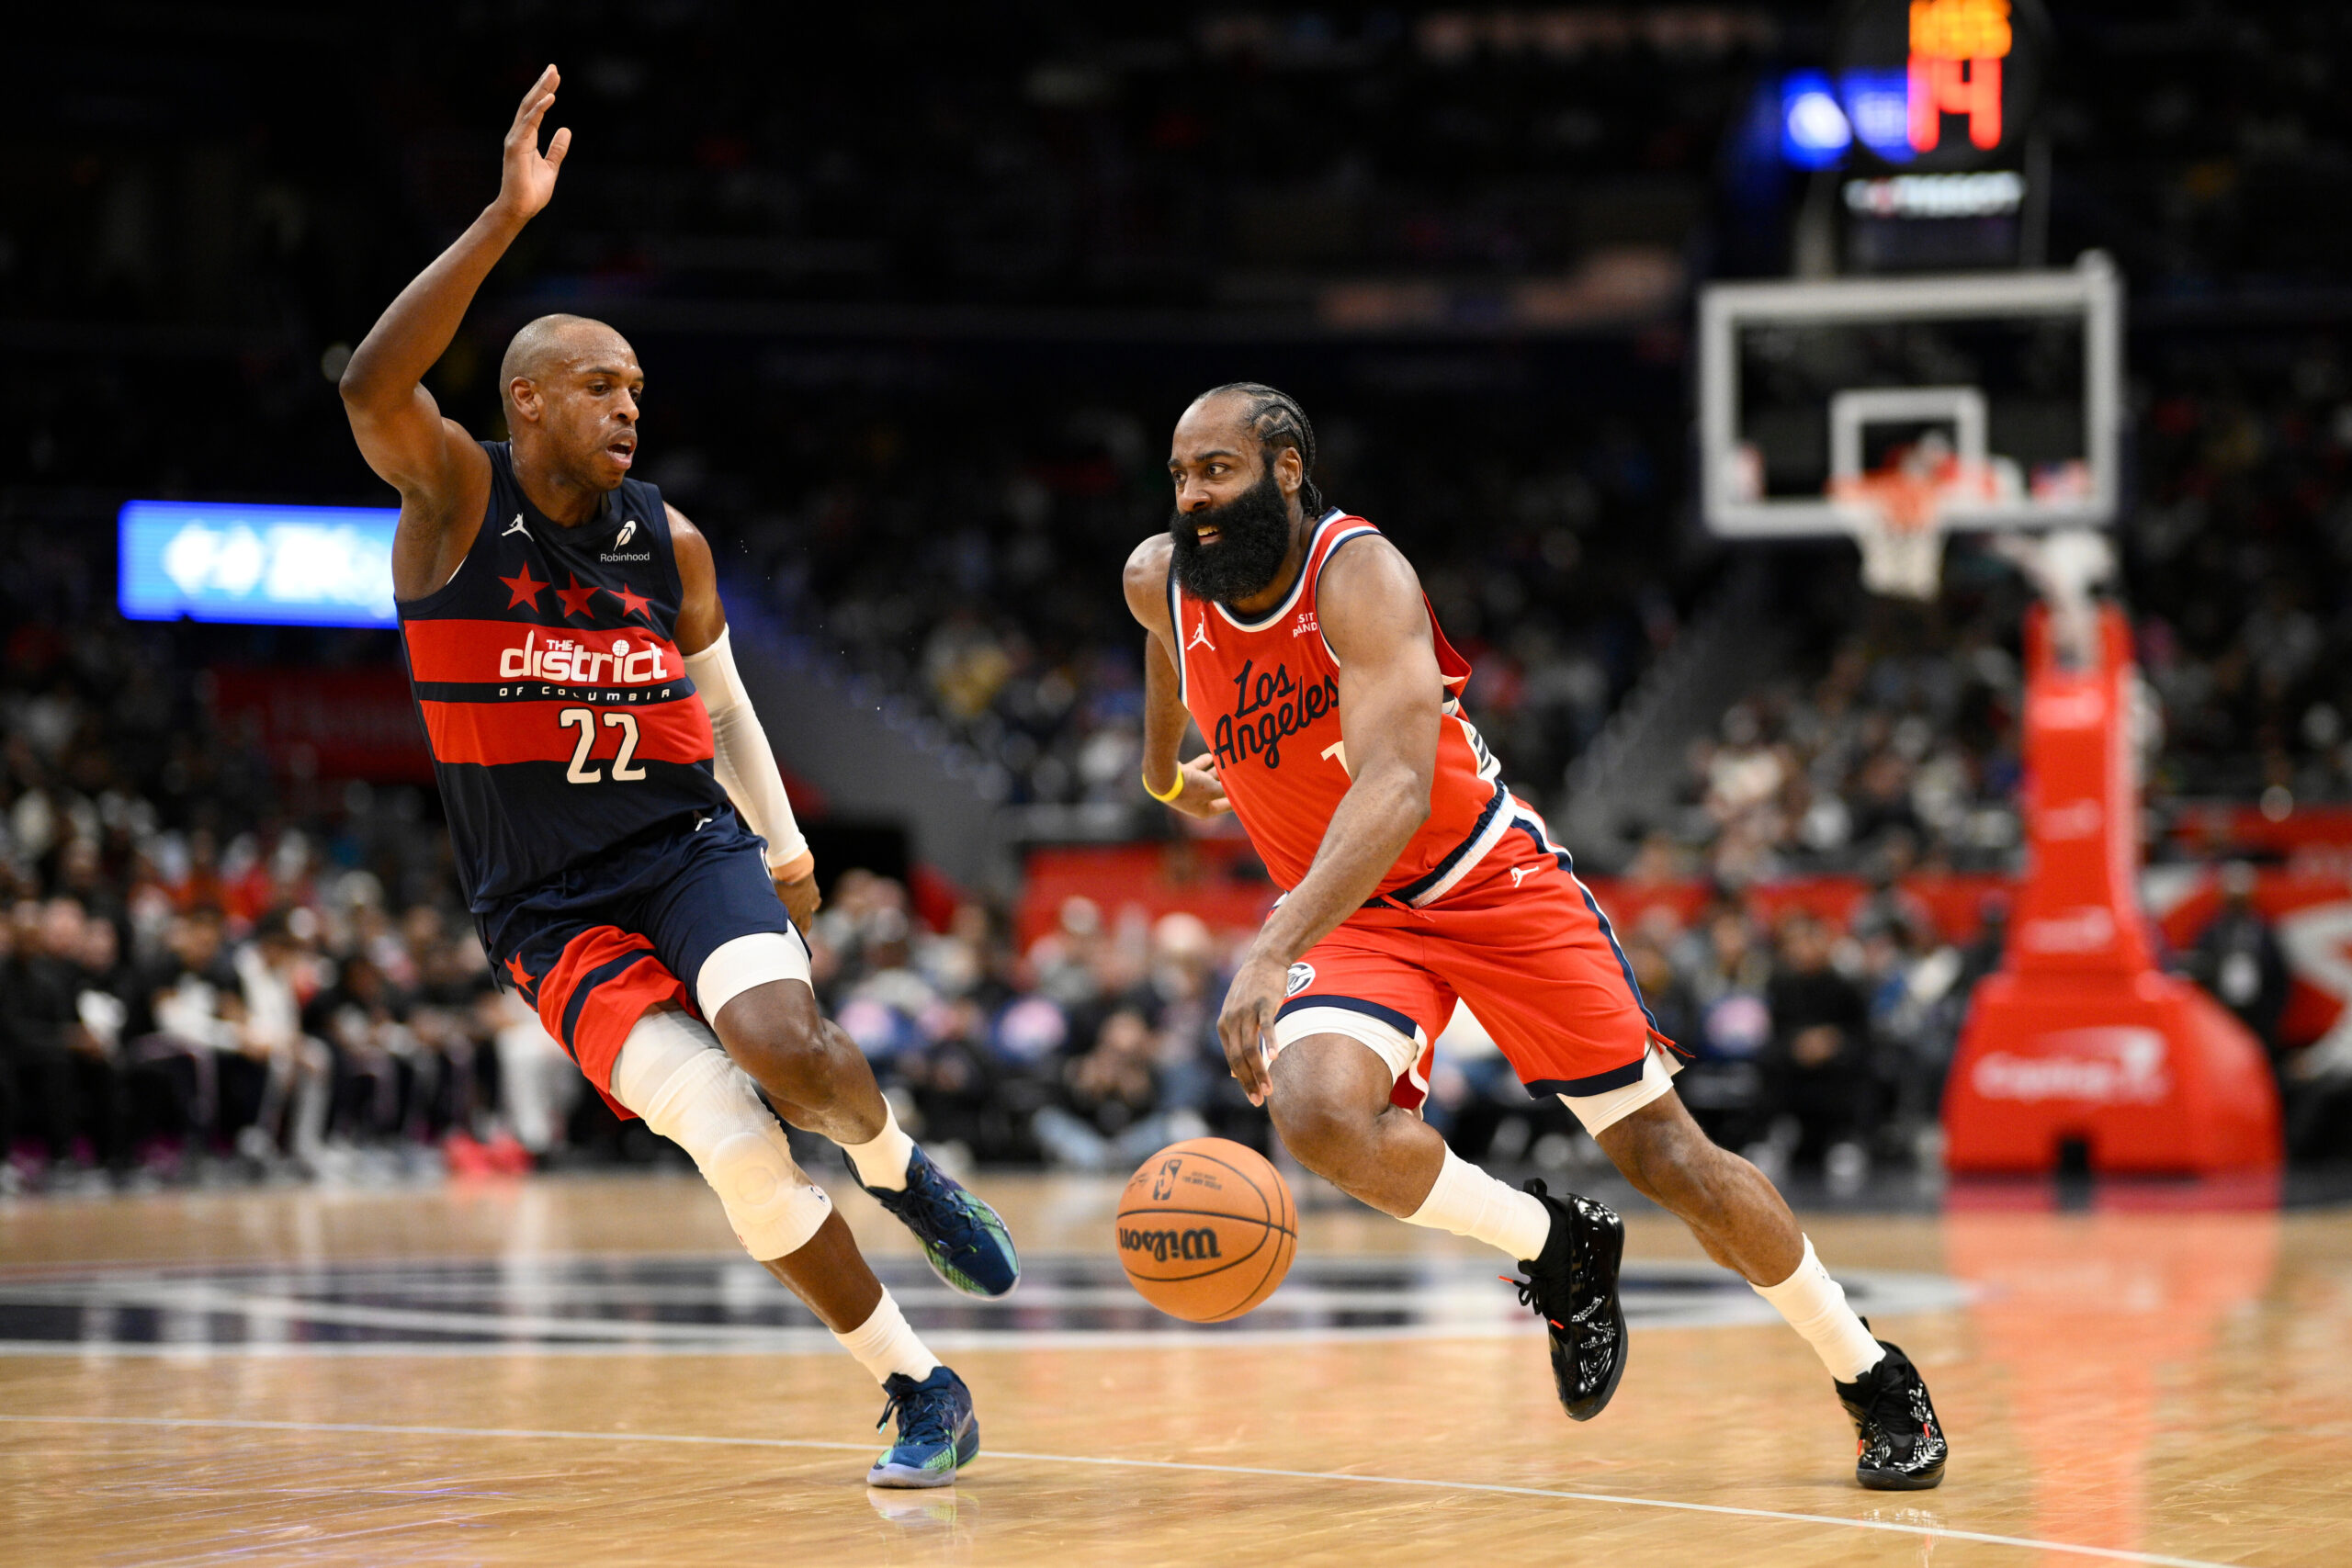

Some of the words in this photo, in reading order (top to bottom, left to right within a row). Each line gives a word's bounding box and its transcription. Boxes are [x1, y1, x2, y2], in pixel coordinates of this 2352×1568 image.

[600, 551, 650, 562] Robinhood
[500, 629, 667, 682] district
[547, 639, 574, 650] THE
[500, 687, 524, 696] OF
[1234, 660, 1295, 718] Los
[1214, 674, 1340, 770] Angeles
[560, 708, 647, 784] 22
[1119, 1227, 1222, 1262] Wilson
